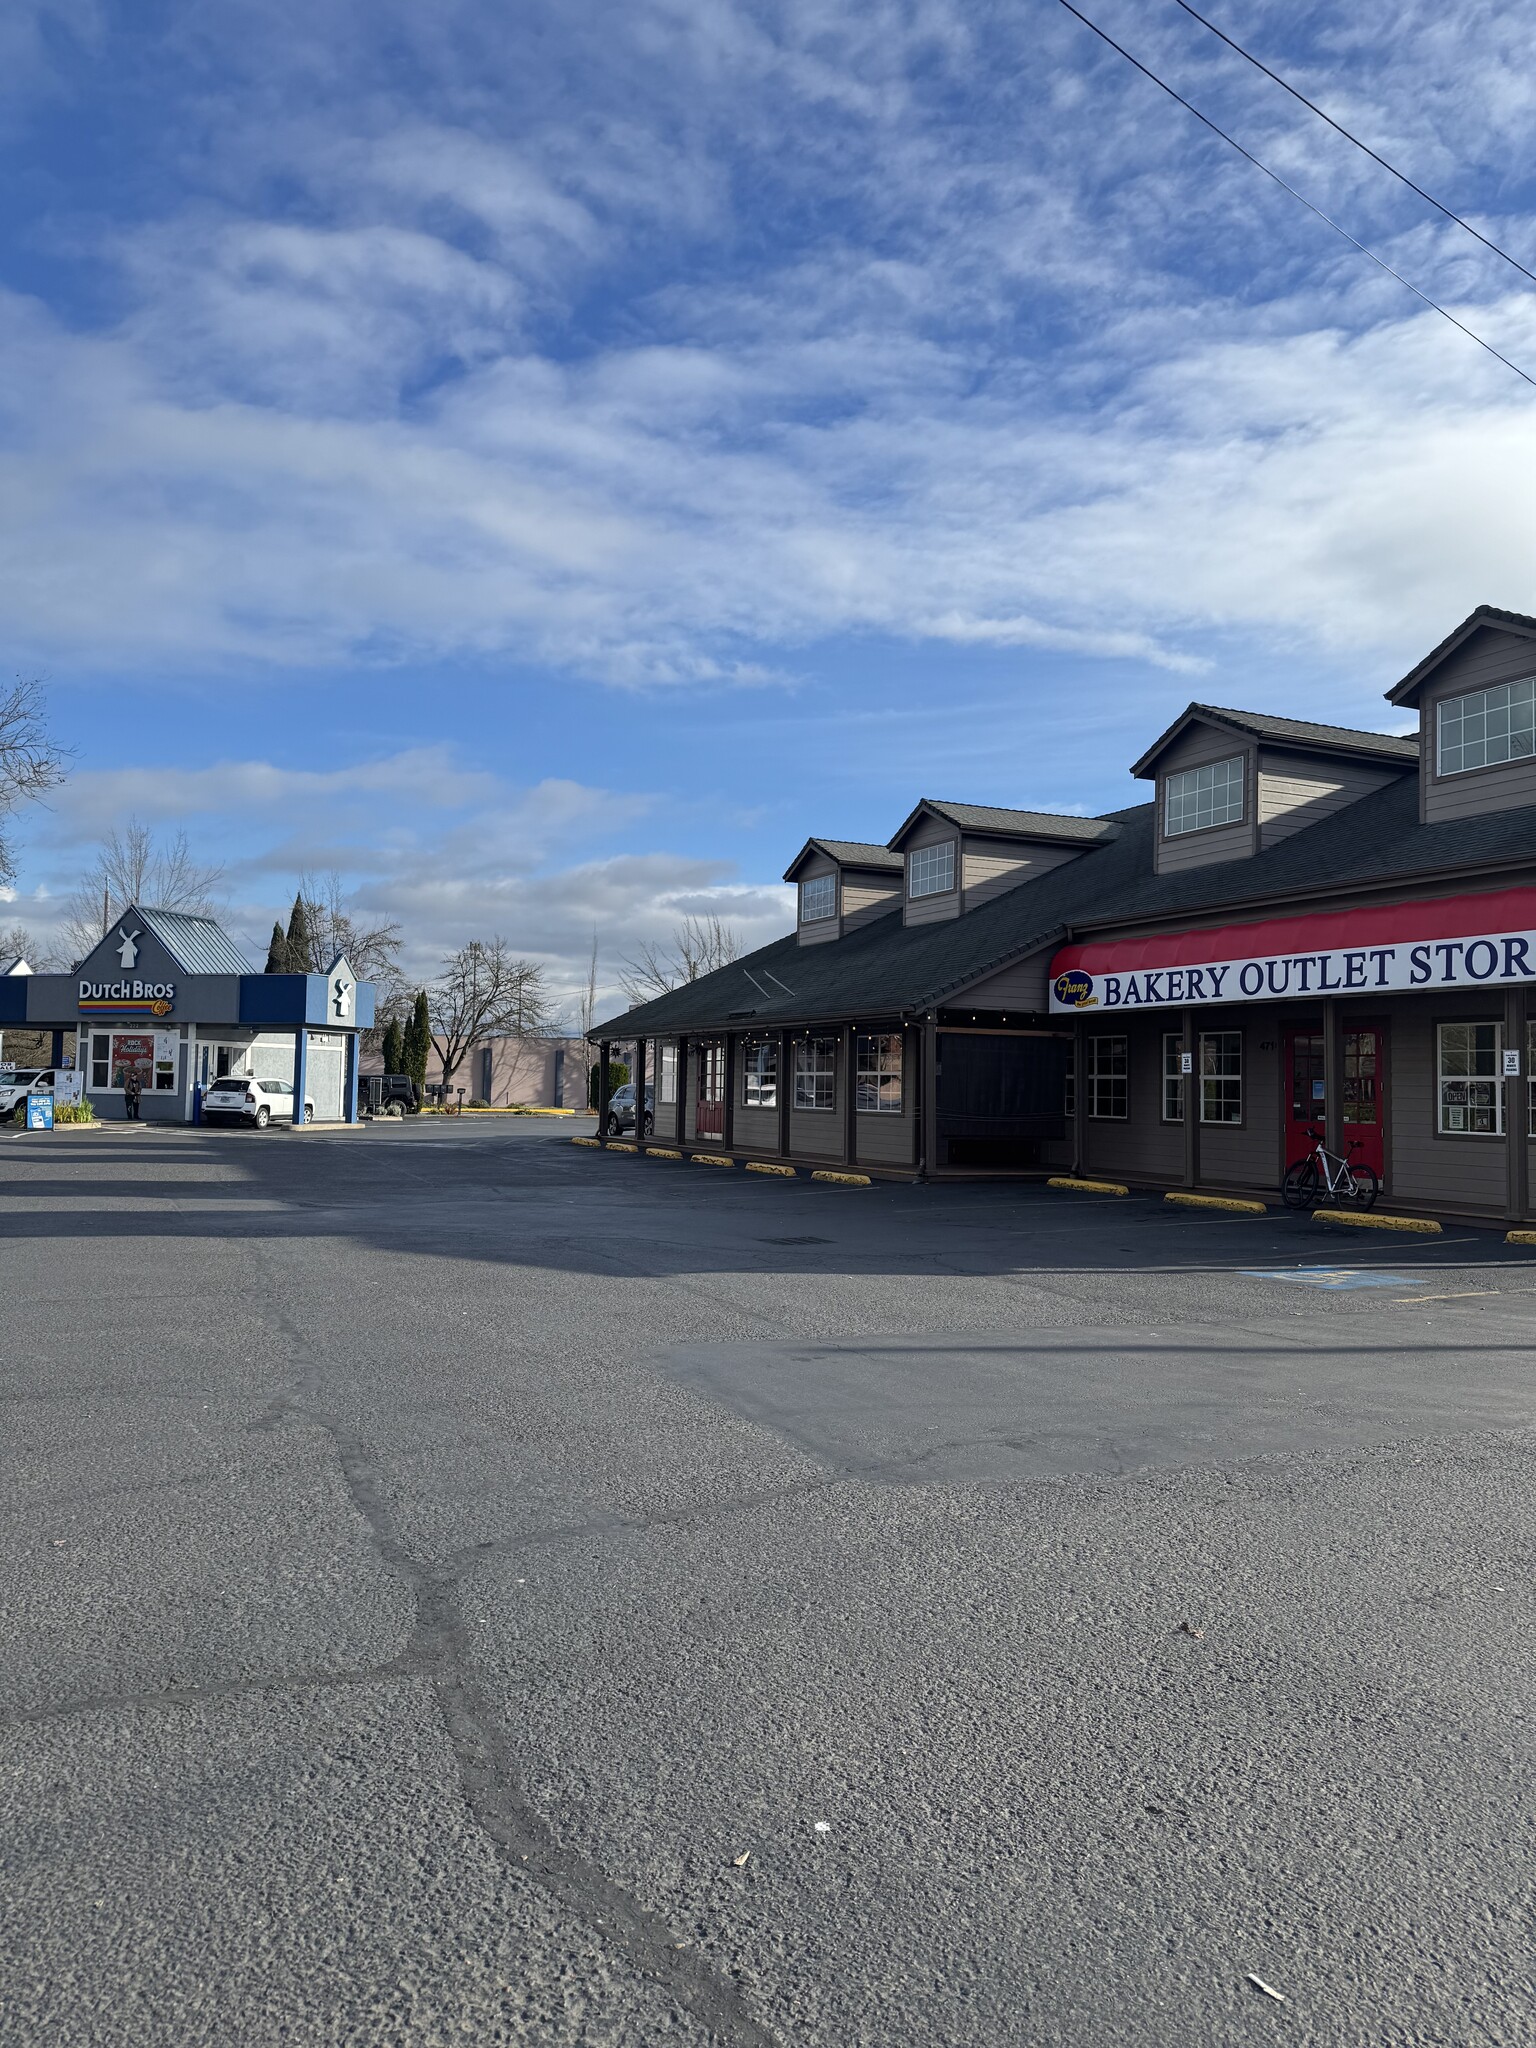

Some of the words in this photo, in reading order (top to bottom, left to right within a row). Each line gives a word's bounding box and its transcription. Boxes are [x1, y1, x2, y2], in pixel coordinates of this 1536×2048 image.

[1103, 965, 1230, 1006] BAKERY
[1239, 949, 1395, 996] OUTLET
[1410, 937, 1536, 985] STOR
[1057, 976, 1089, 1001] Franz
[1447, 1092, 1466, 1101] OPEN
